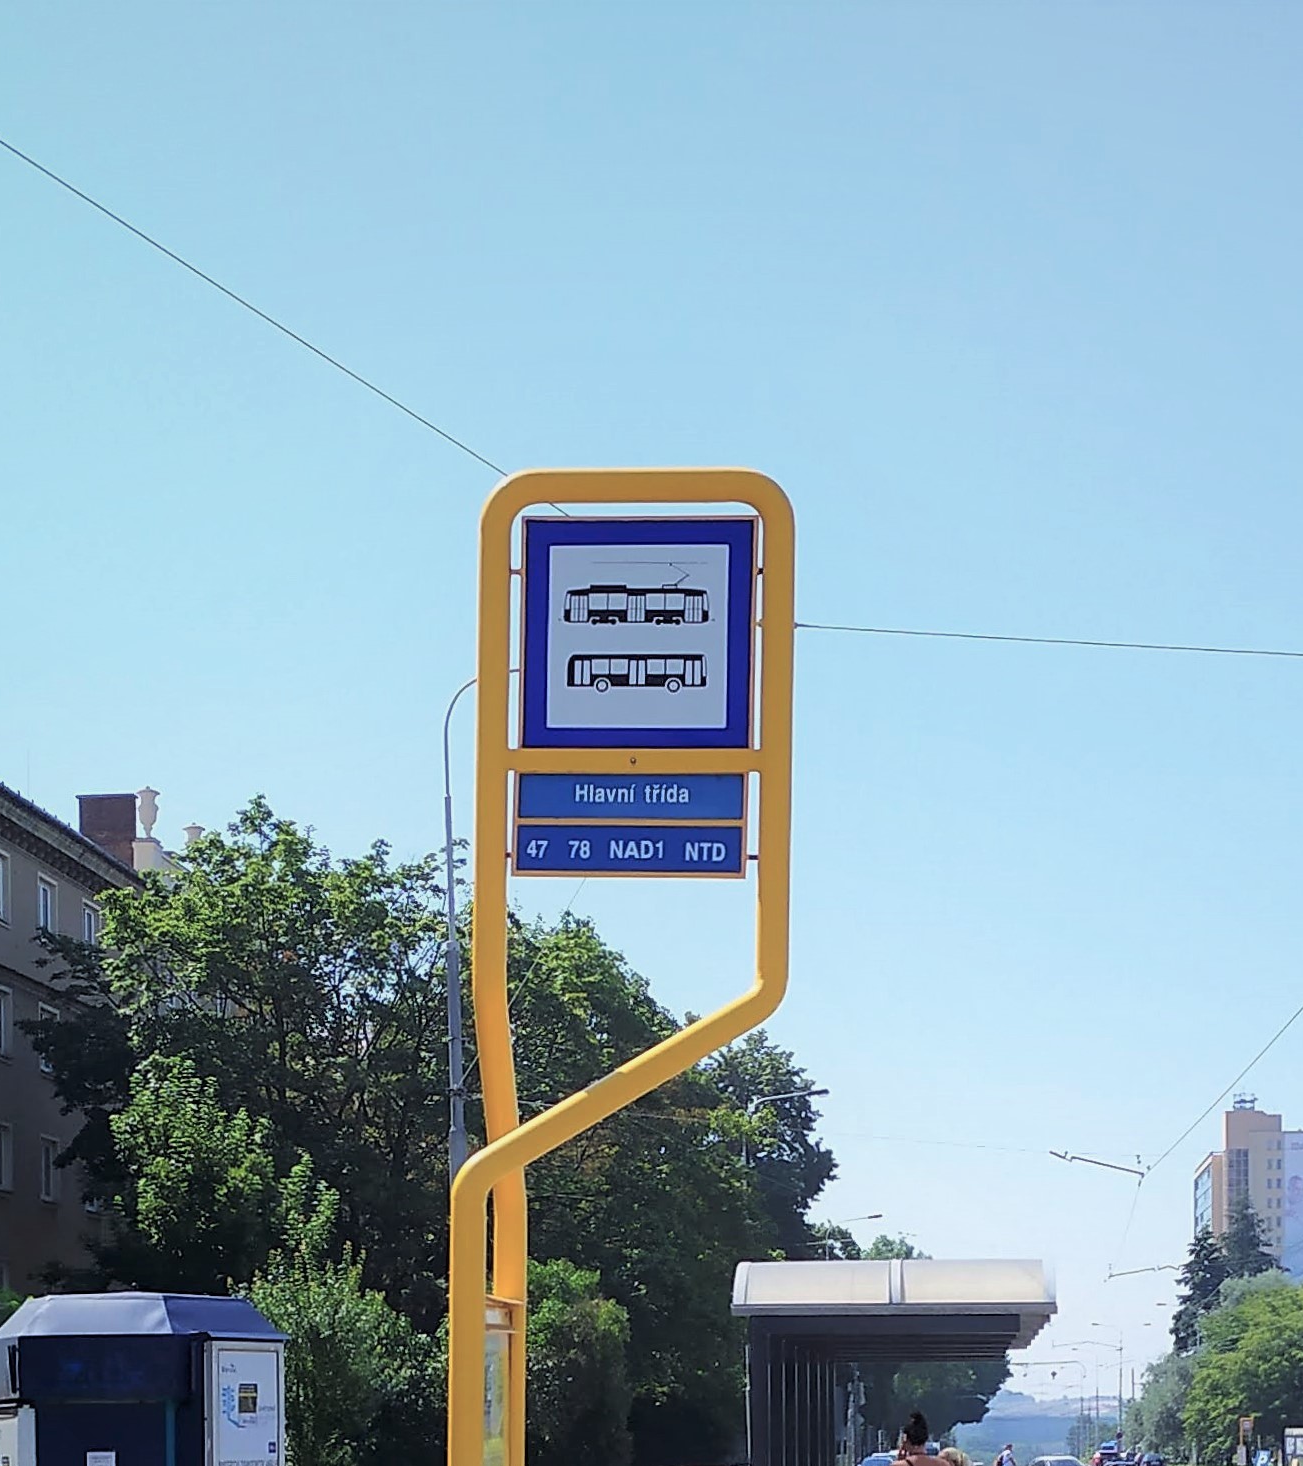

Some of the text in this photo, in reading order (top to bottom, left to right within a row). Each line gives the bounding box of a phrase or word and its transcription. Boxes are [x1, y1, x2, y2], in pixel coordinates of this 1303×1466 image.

[574, 783, 689, 803] Hlavní třída
[526, 840, 726, 862] 47 78 NAD1 NTD
